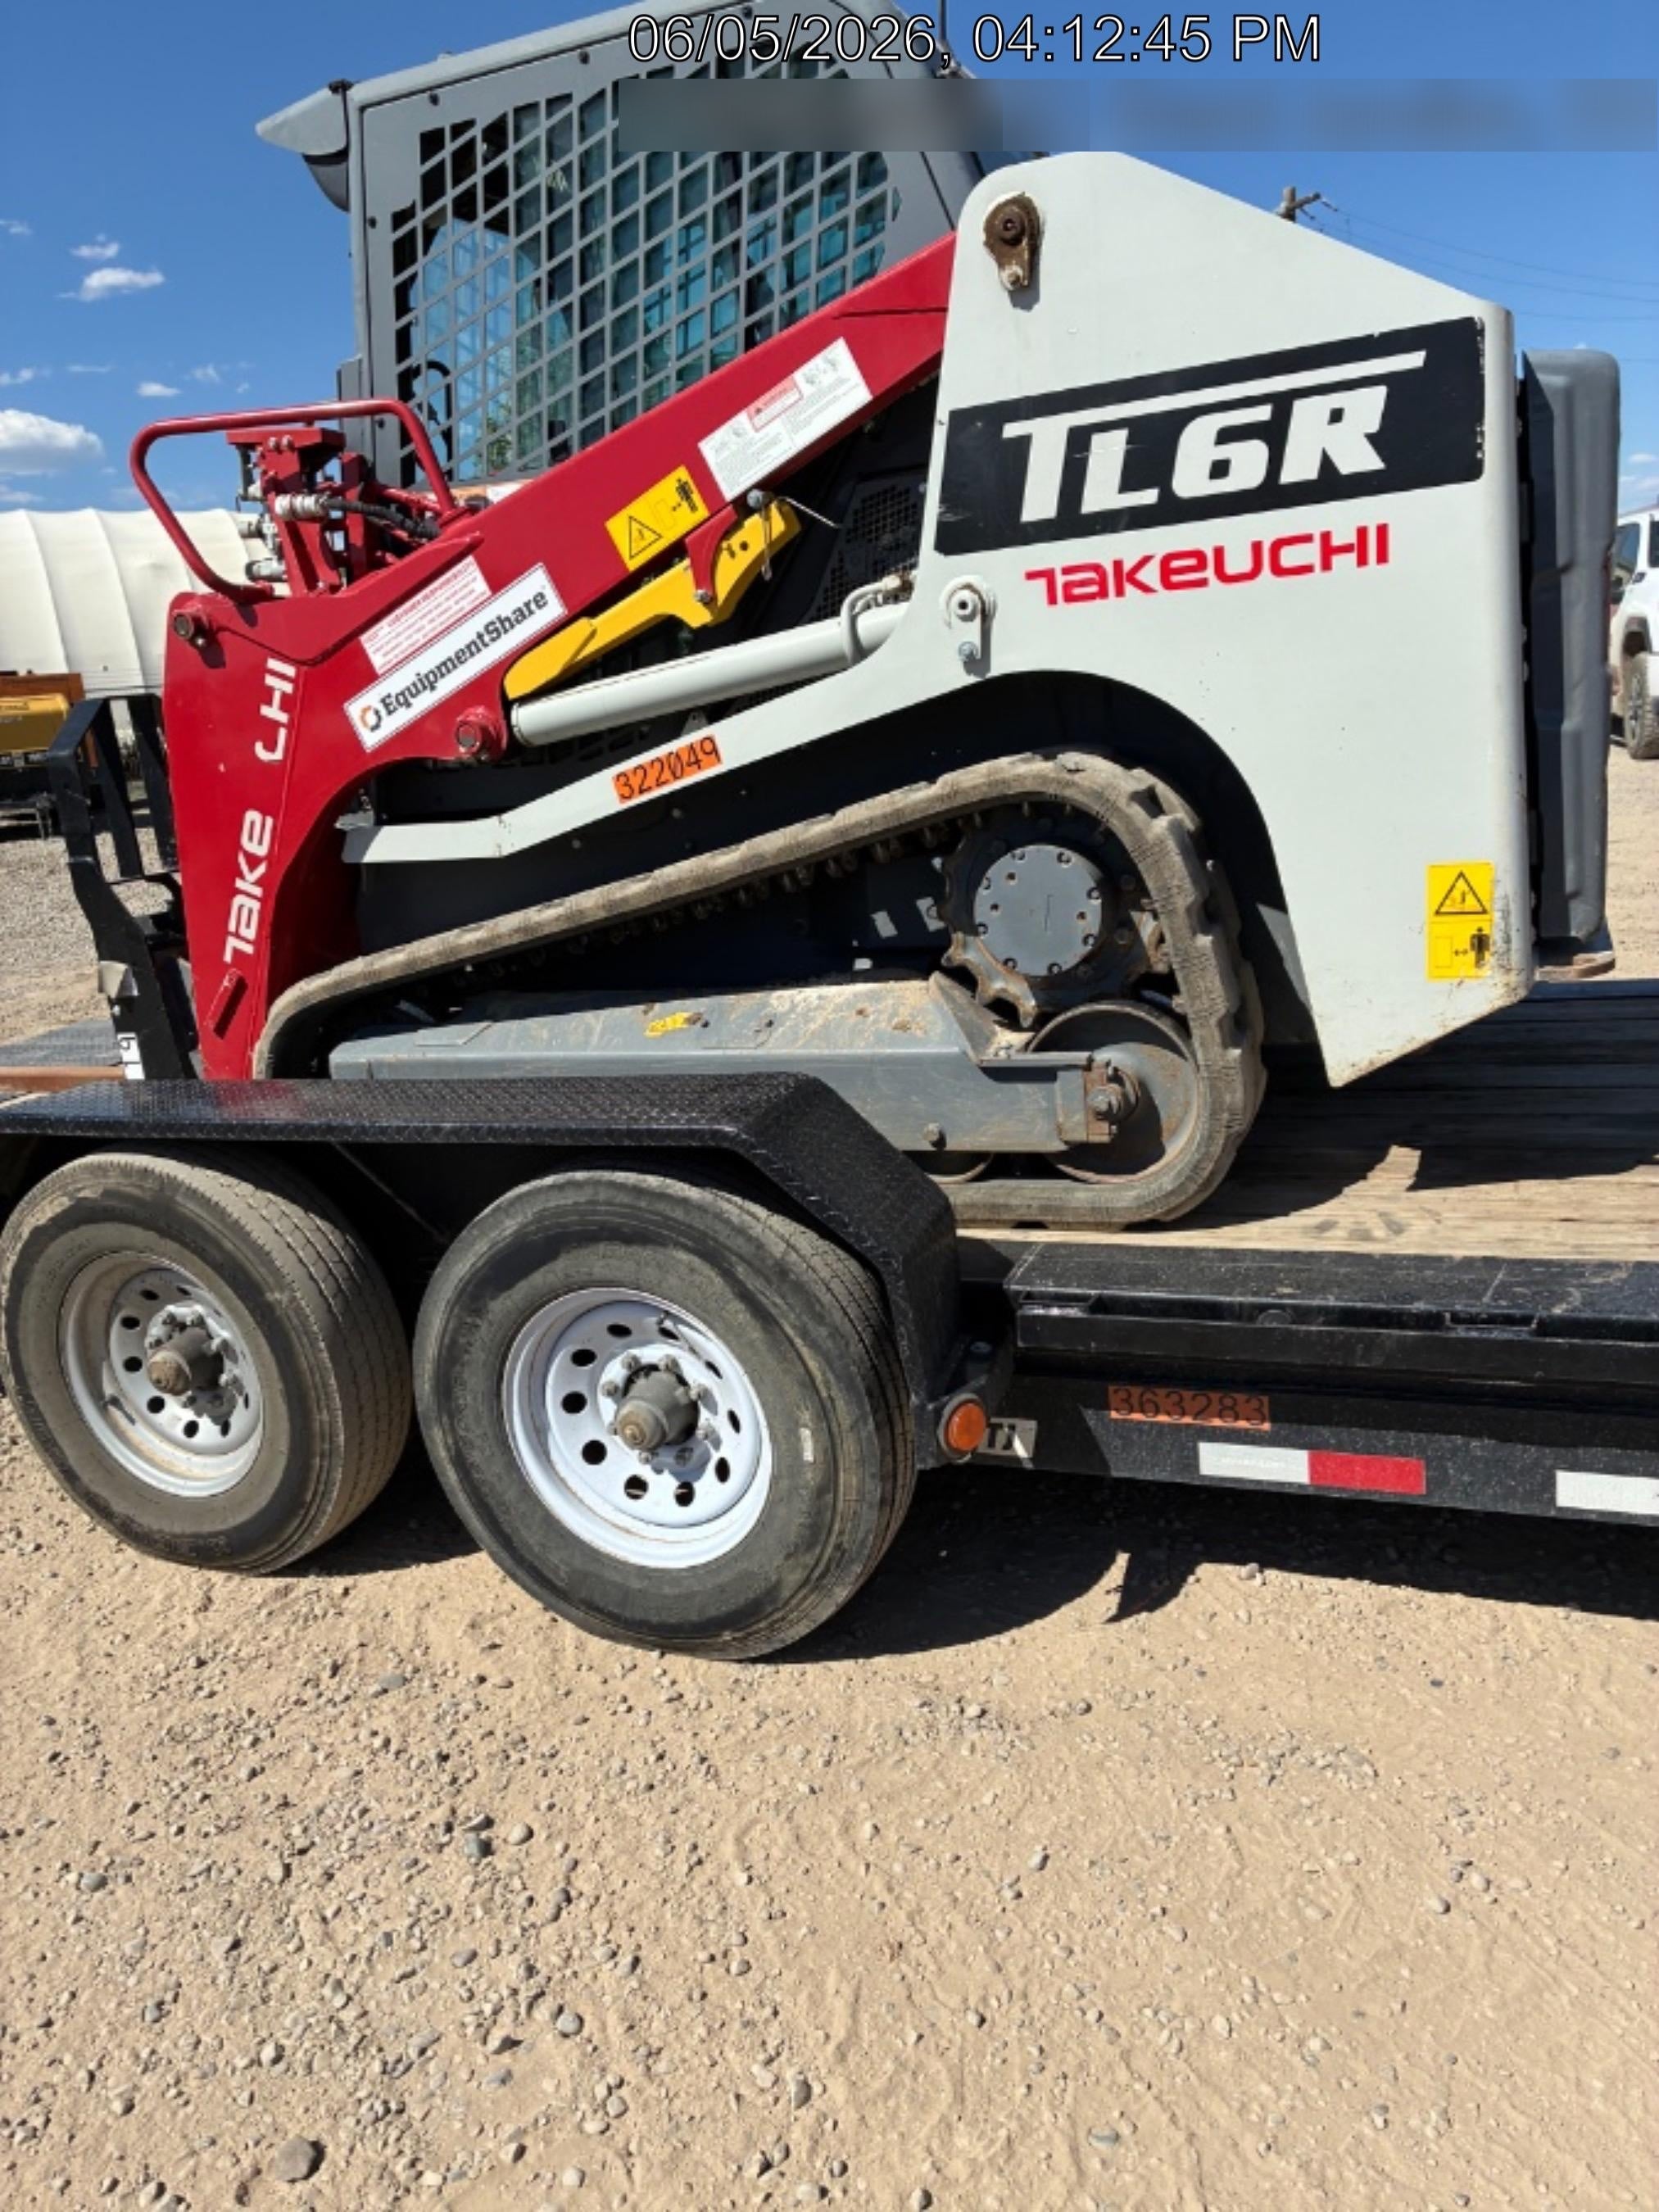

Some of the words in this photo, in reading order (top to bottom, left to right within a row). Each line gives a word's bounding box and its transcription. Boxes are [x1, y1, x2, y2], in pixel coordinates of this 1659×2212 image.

[1002, 350, 1426, 524] TL6R
[379, 590, 549, 716] EquipmentShare
[616, 736, 723, 800] 322049
[1113, 1387, 1267, 1426] 363283
